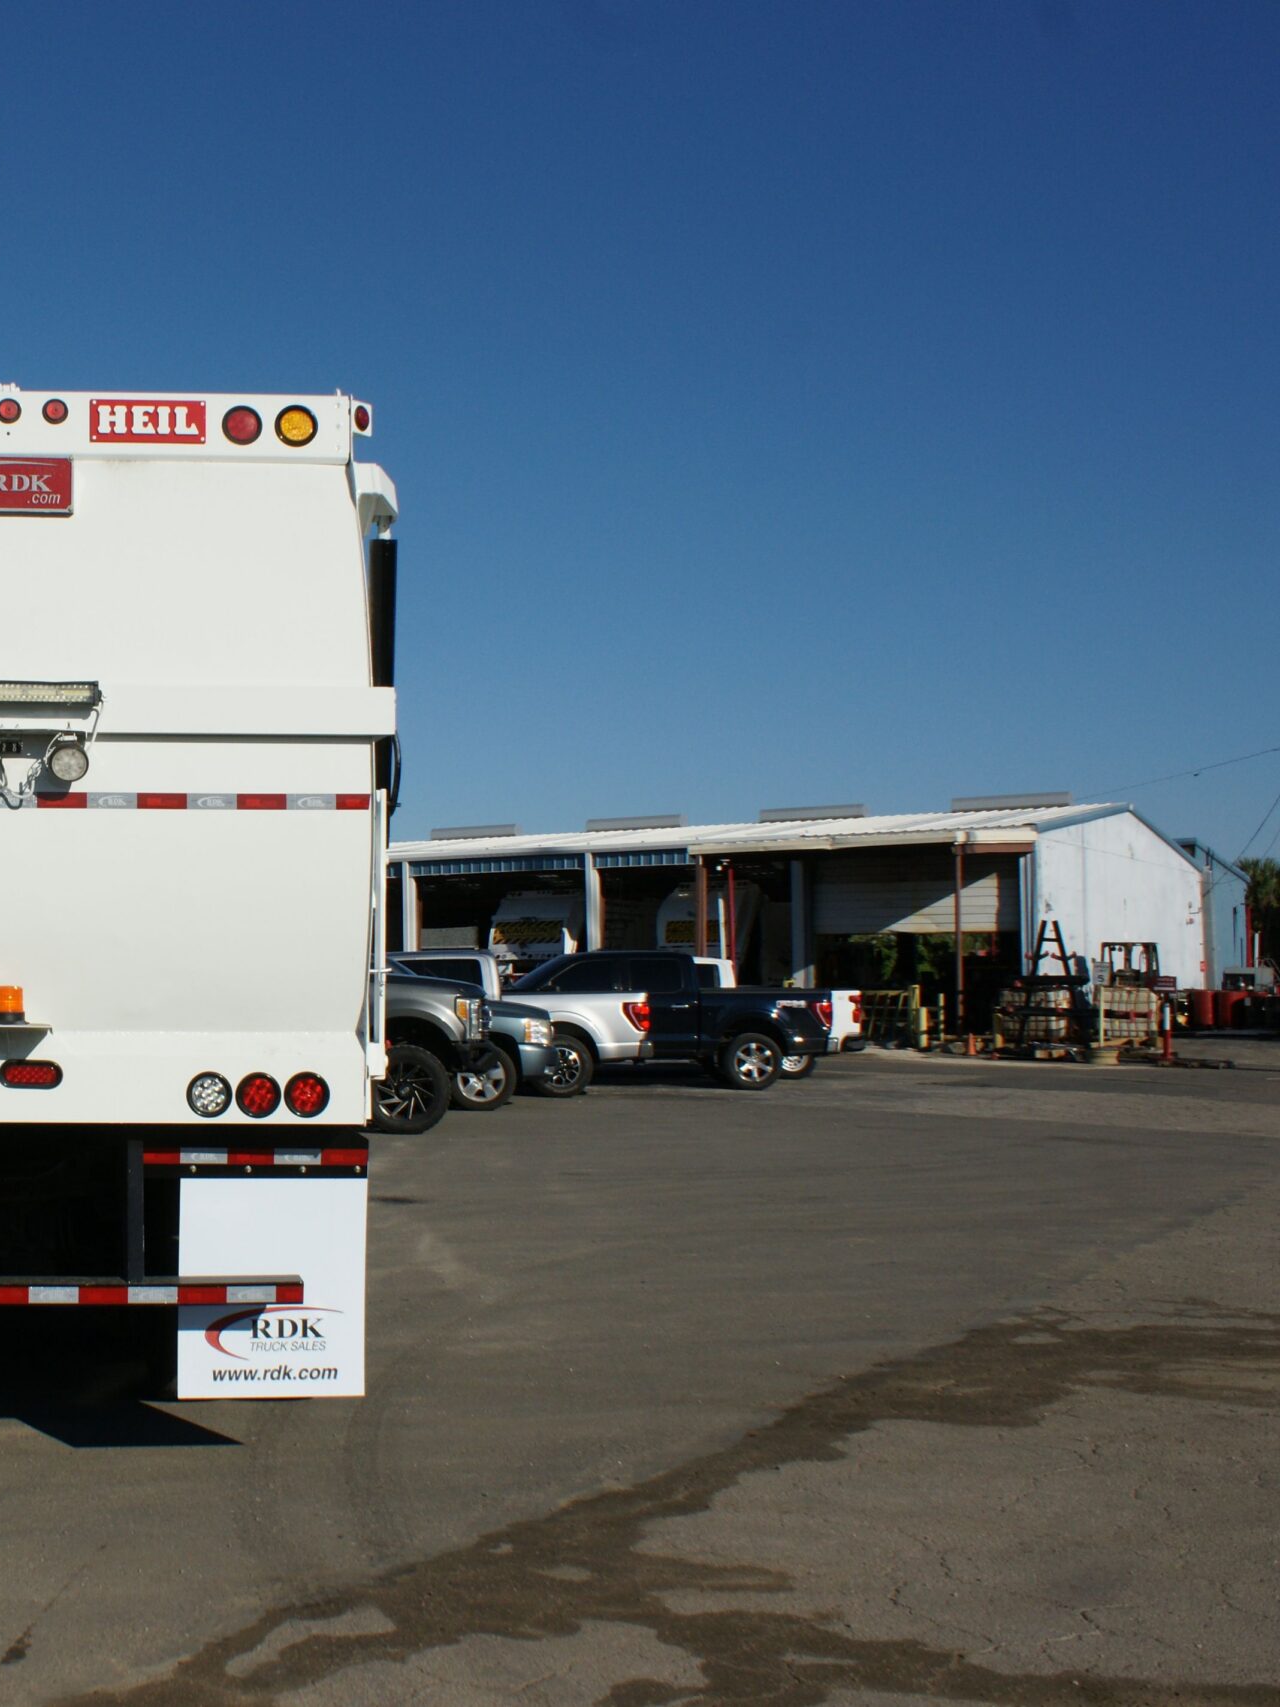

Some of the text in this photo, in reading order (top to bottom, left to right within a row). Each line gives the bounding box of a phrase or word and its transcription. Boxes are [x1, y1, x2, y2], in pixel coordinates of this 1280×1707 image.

[97, 405, 199, 435] HEIL
[27, 493, 61, 505] .com
[250, 1318, 325, 1339] RDK
[250, 1341, 327, 1352] TRUCK SALES
[212, 1365, 338, 1381] www.rdk.com
